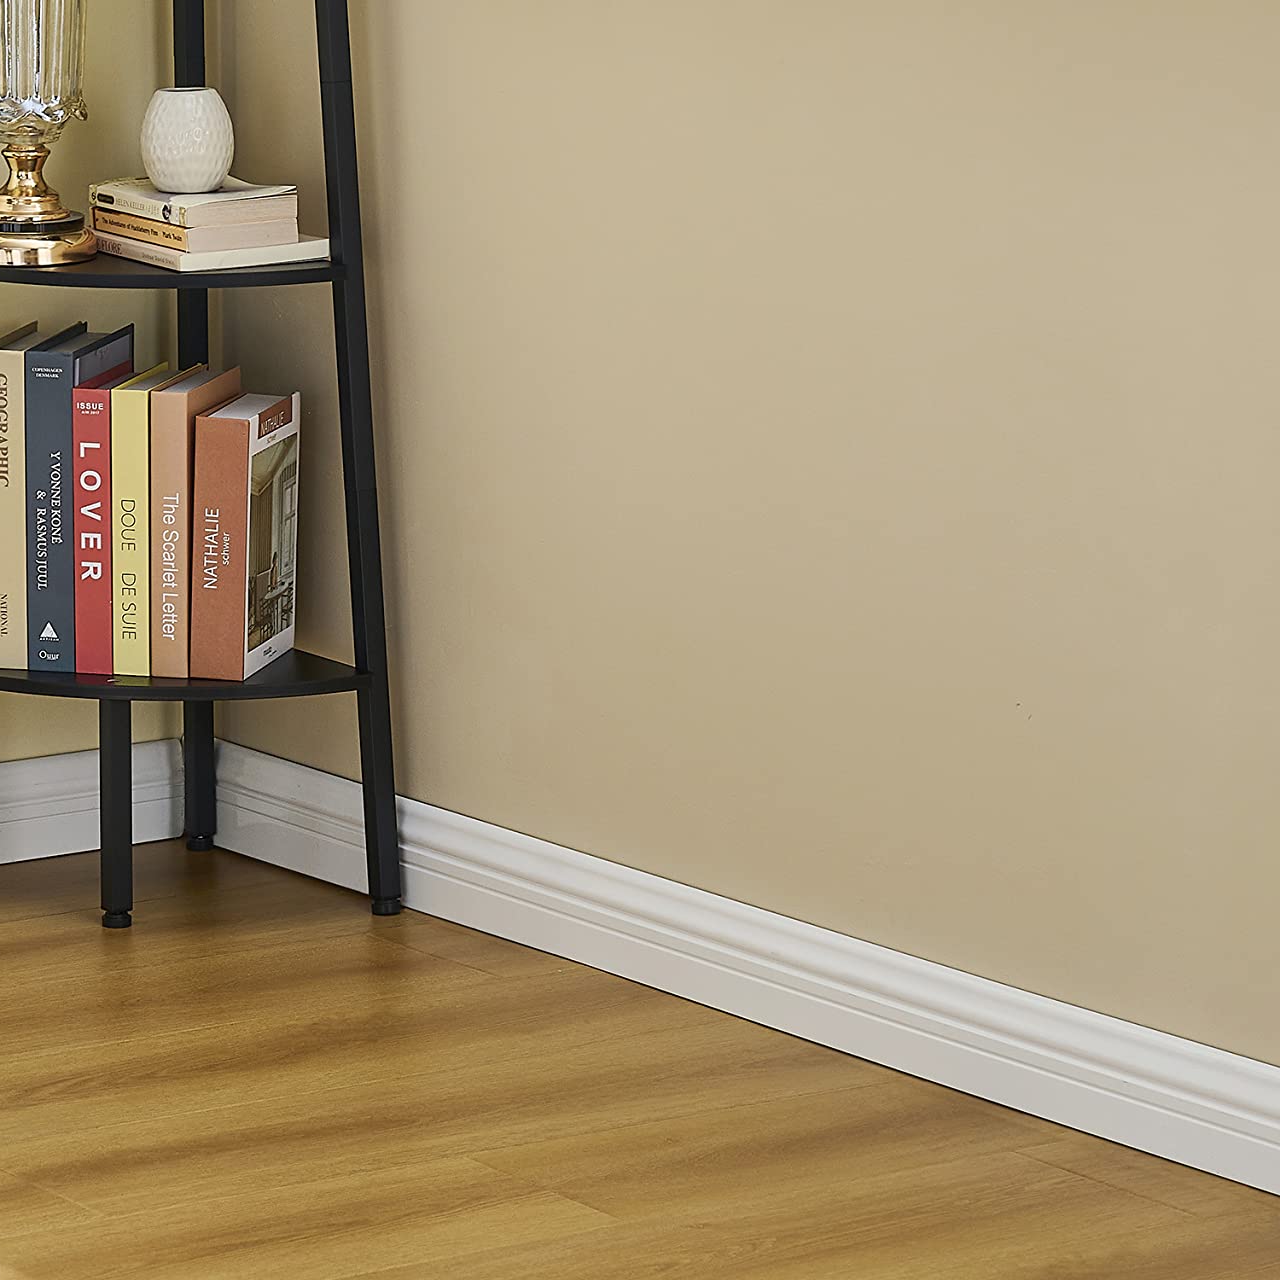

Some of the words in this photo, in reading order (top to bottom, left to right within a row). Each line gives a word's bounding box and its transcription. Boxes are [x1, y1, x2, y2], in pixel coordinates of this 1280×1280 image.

[76, 402, 104, 410] ISSUE
[36, 490, 47, 500] &
[50, 451, 61, 507] YVONNE
[51, 510, 63, 544] KONÉ
[79, 442, 103, 581] LOVER
[121, 499, 136, 551] DOUE
[162, 493, 179, 524] The
[36, 508, 47, 558] RASMUS
[203, 507, 220, 589] NATHALIE
[221, 532, 230, 565] schwer
[36, 559, 48, 591] JUUL
[162, 529, 179, 588] Scarlet
[121, 573, 136, 596] DE
[0, 593, 8, 637] NATIONAL
[121, 602, 137, 640] SUIE
[162, 593, 179, 640] Letter
